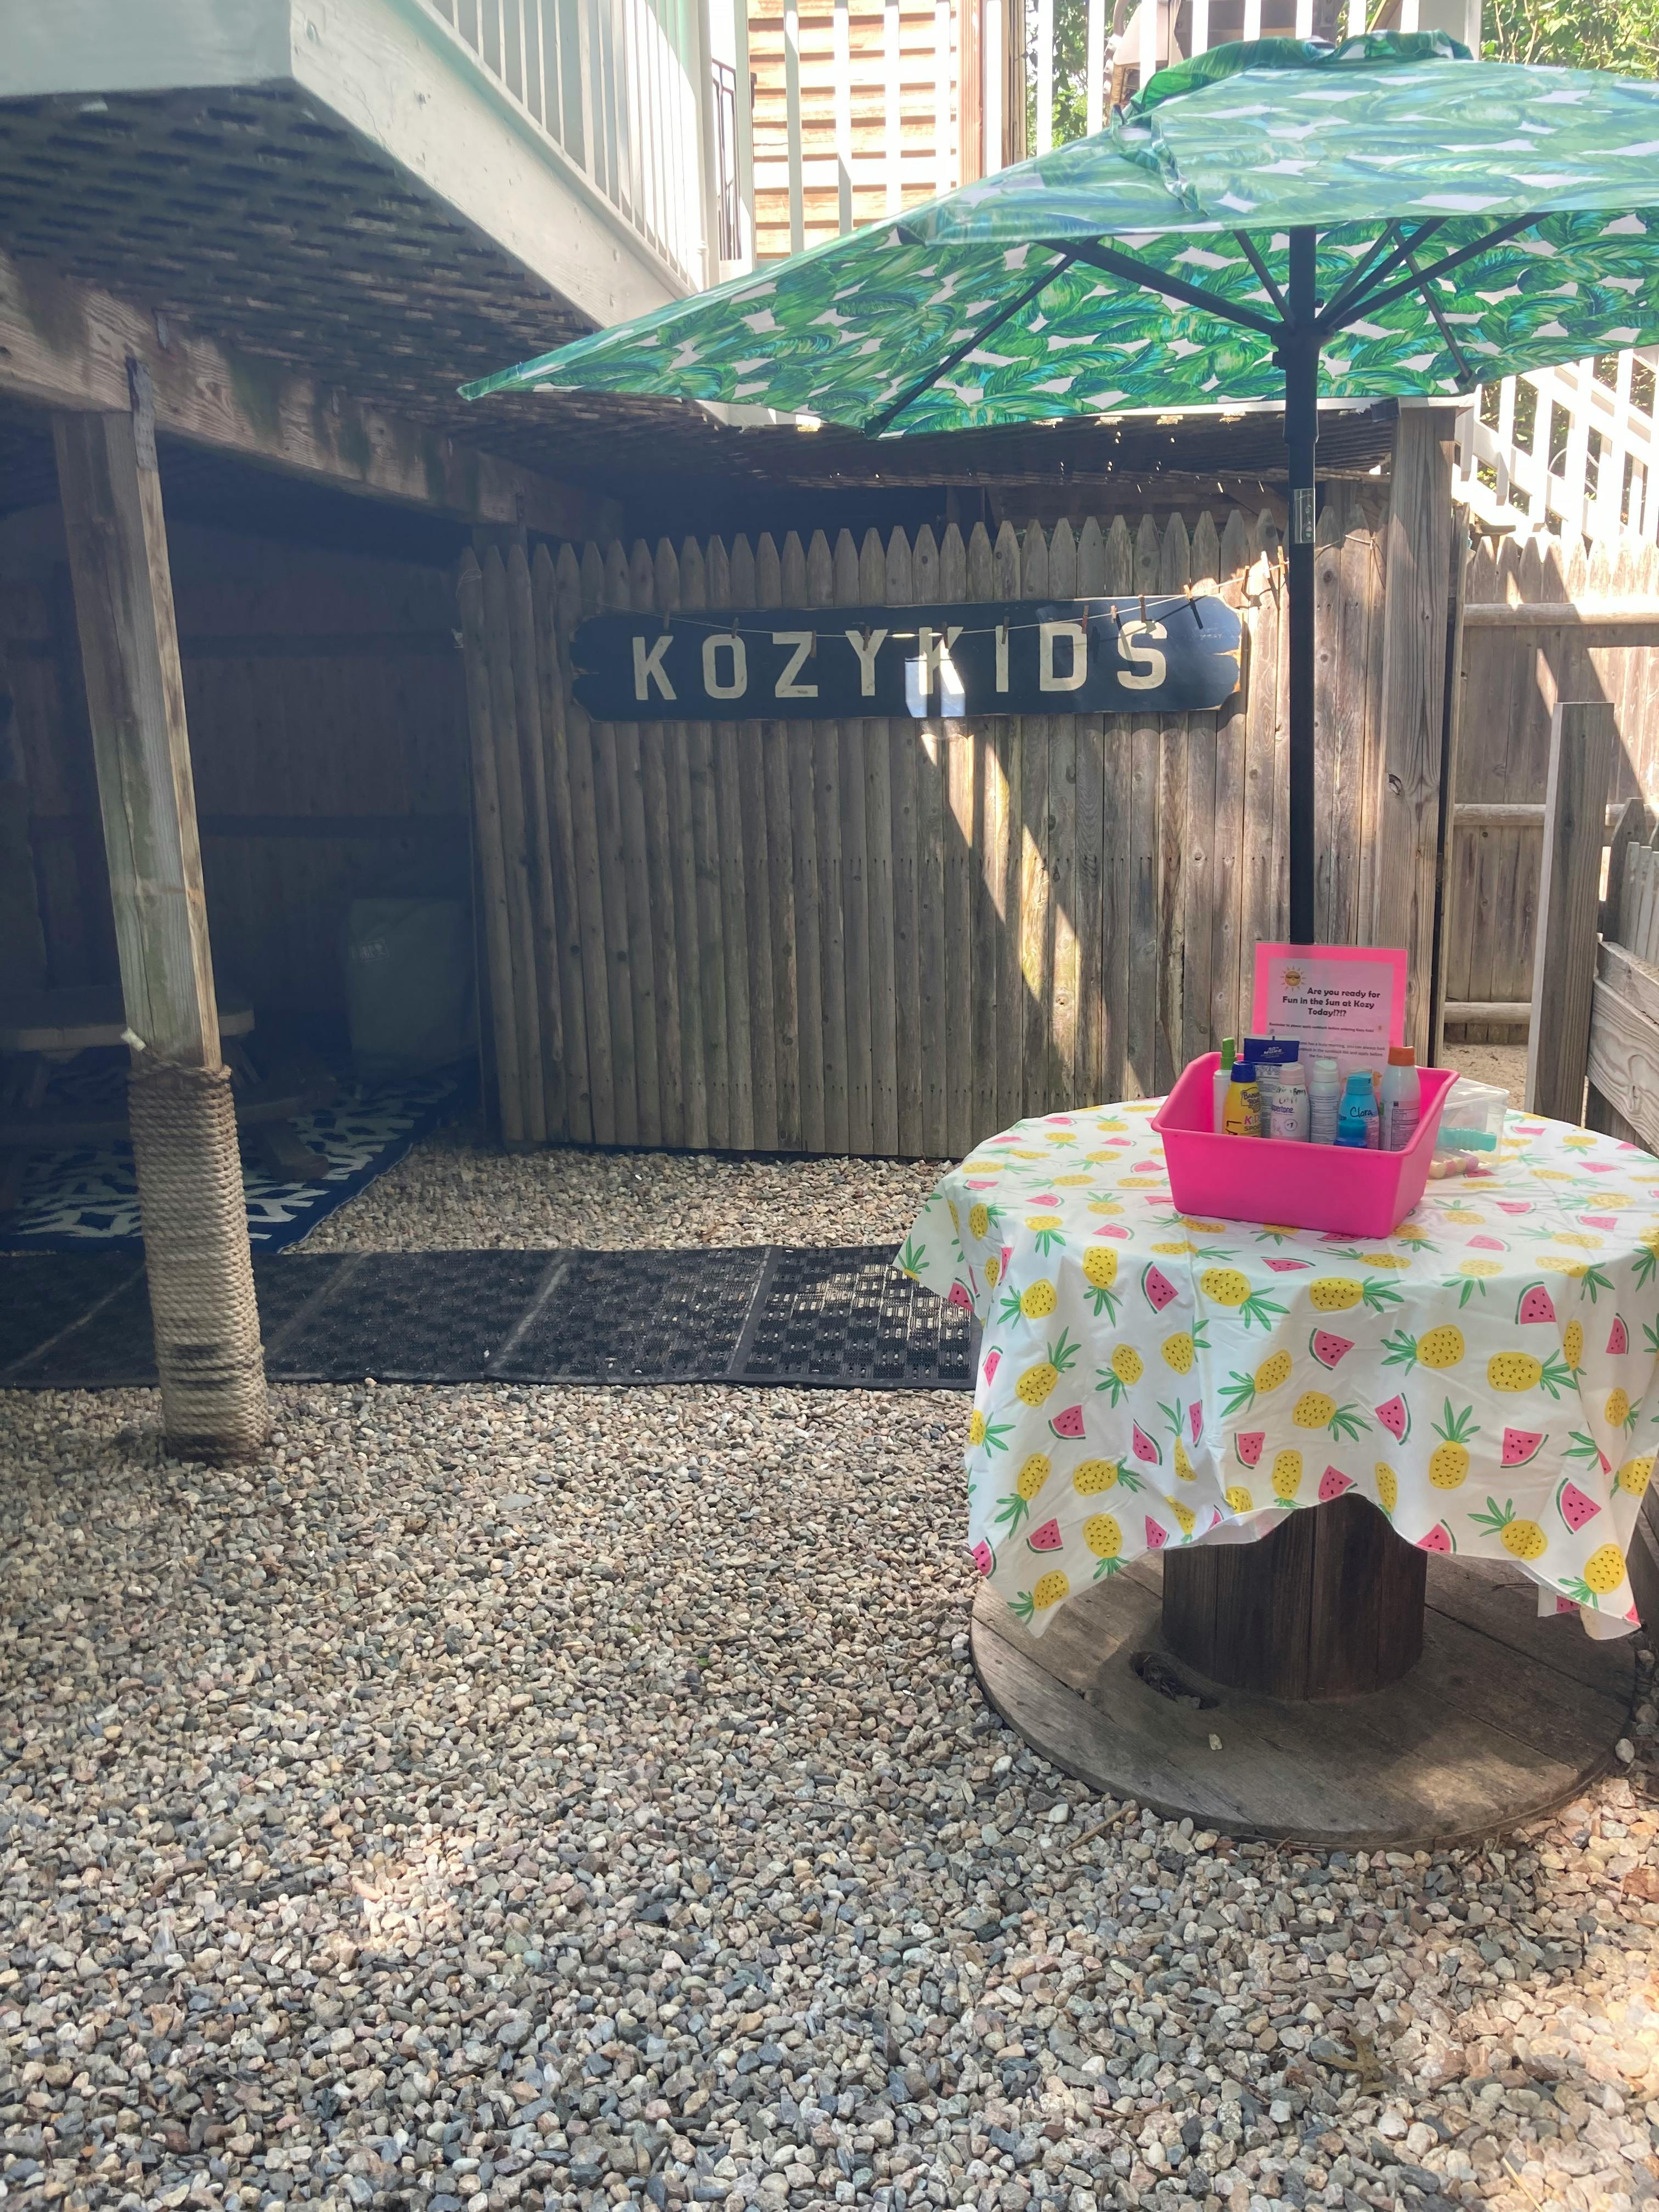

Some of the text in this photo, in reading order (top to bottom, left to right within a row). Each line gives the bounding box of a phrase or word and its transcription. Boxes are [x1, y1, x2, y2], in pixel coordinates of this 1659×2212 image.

[1341, 990, 1366, 998] ready
[1353, 1000, 1374, 1009] Kozy
[1308, 1008, 1346, 1017] Today!?!?
[1244, 1115, 1259, 1125] KID
